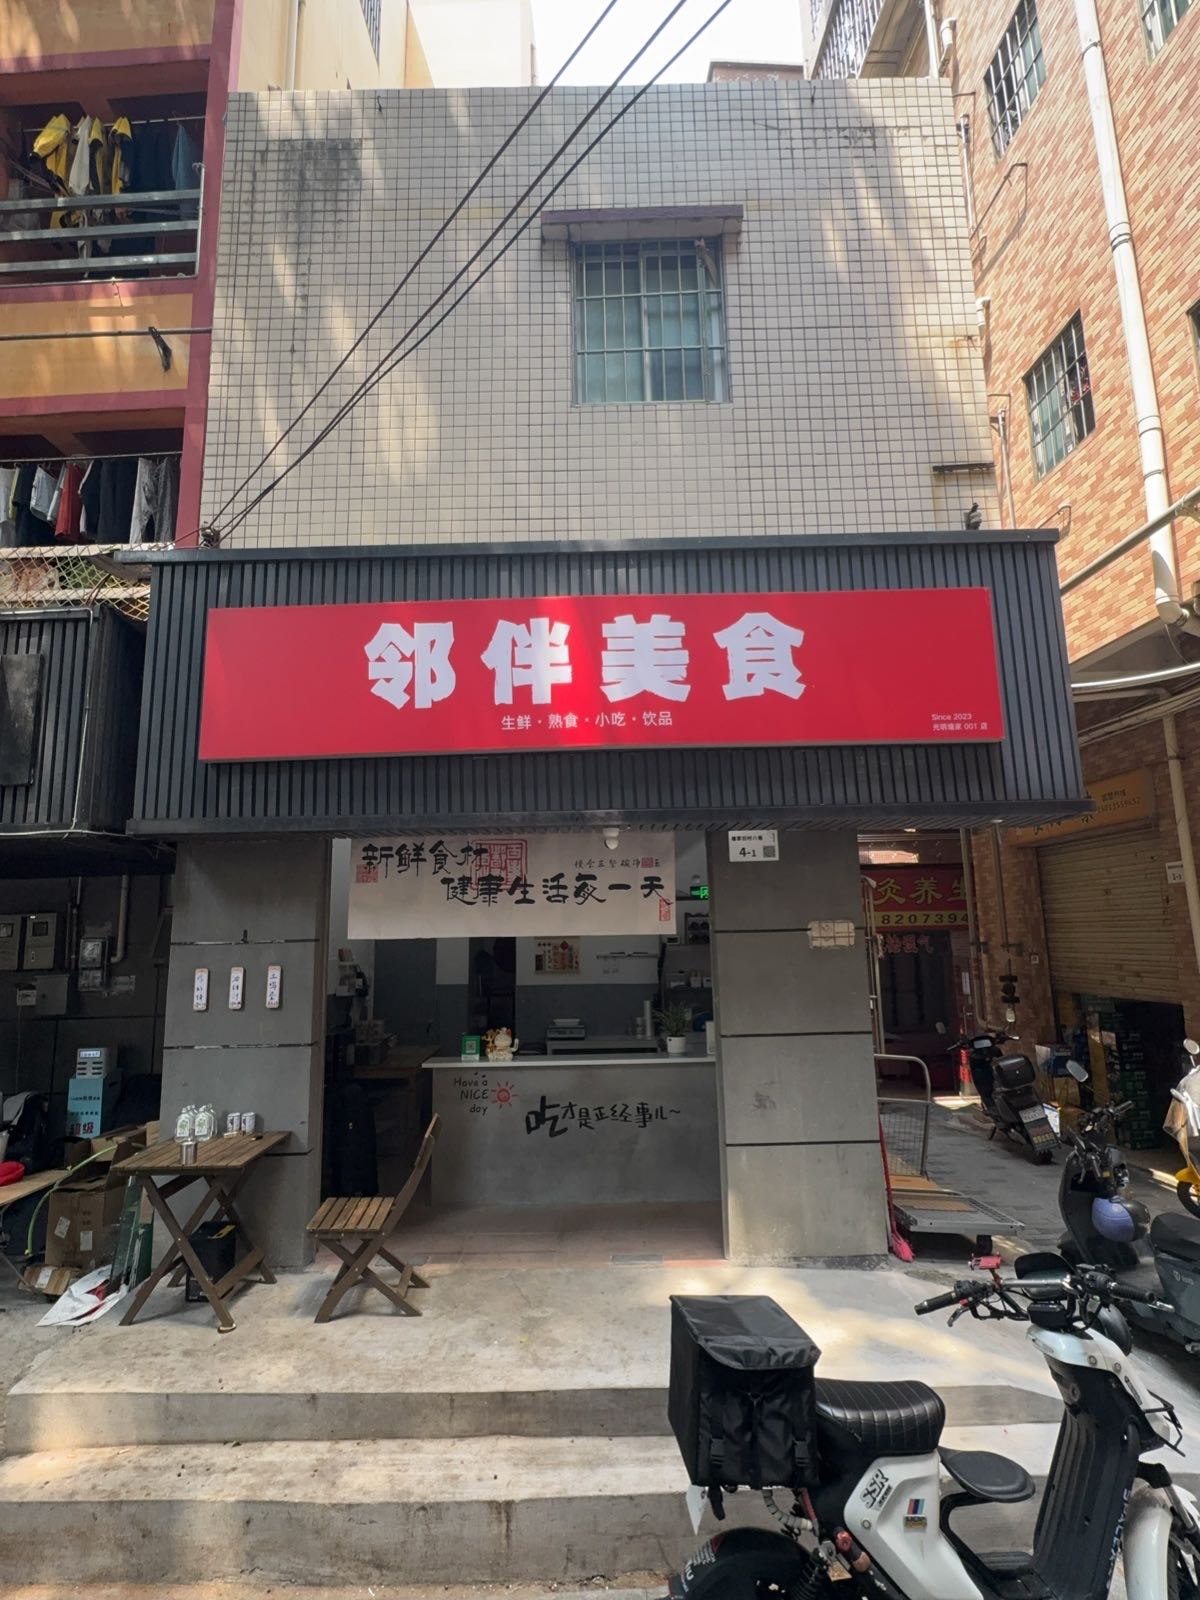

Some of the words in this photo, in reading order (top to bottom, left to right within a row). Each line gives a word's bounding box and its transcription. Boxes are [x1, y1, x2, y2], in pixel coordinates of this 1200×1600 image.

[364, 611, 807, 709] 邻伴美食
[963, 722, 978, 730] 001
[361, 839, 489, 879] 新鲜食材
[739, 847, 757, 858] 4-1
[440, 872, 674, 908] 健康生活每一天
[454, 1077, 479, 1087] Have
[460, 1088, 489, 1101] NICE
[469, 1104, 488, 1116] day
[860, 1468, 889, 1509] SSR
